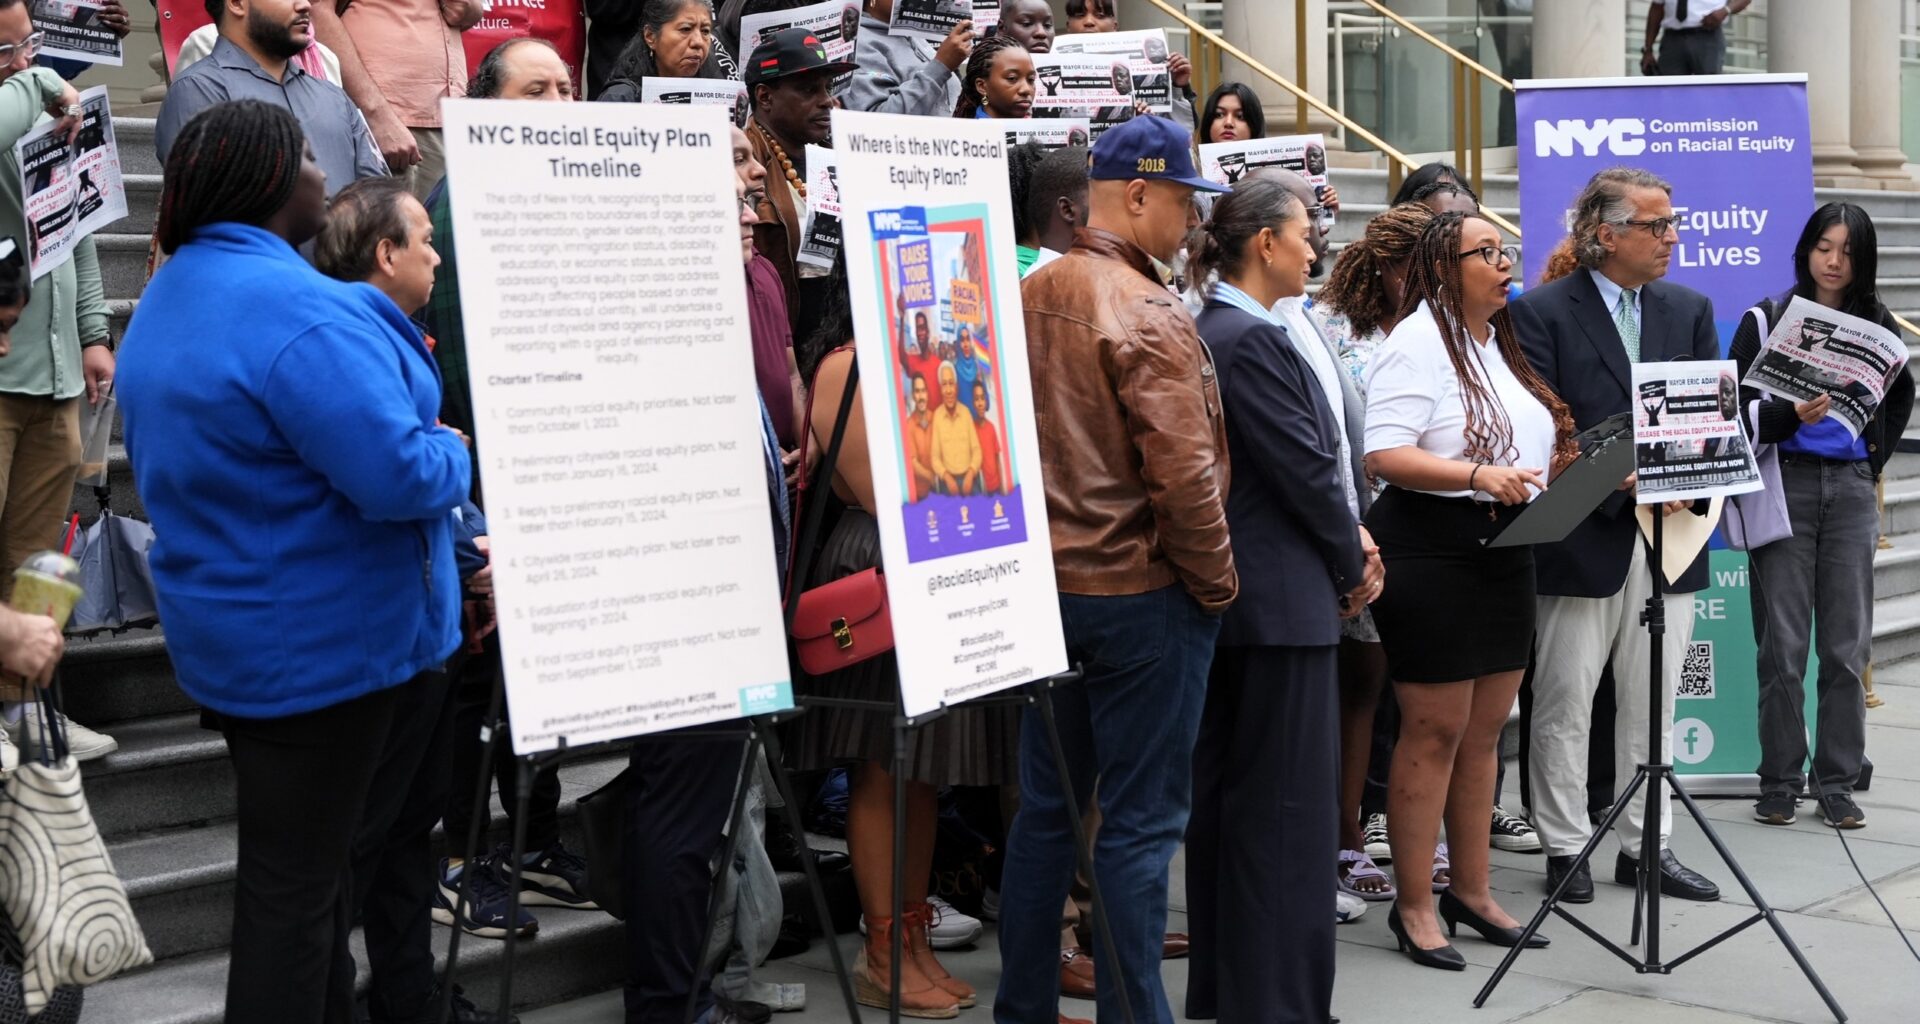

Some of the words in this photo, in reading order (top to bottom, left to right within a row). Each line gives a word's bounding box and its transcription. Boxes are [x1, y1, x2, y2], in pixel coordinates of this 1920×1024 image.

[472, 17, 512, 29] uture.
[794, 19, 814, 27] MAYOR
[902, 11, 931, 21] RELEASE
[43, 22, 60, 31] RACIAL
[61, 25, 82, 35] EQUITY
[84, 29, 99, 37] PLAN
[100, 32, 115, 40] NOW
[1650, 118, 1758, 133] Commission
[467, 124, 514, 144] NYC
[520, 124, 588, 145] Racial
[593, 126, 659, 151] Equity
[665, 127, 711, 147] Plan
[847, 133, 892, 154] Where
[894, 135, 906, 155] is
[908, 137, 930, 156] the
[933, 138, 960, 157] NYC
[963, 140, 1003, 159] Racial
[1534, 117, 1646, 157] NYC
[1650, 140, 1673, 152] on
[1678, 136, 1733, 151] Racial
[1738, 135, 1795, 153] Equity
[38, 148, 63, 165] EQUITY
[1137, 157, 1166, 173] 2018
[547, 156, 641, 177] Timeline
[889, 165, 930, 190] Equity
[933, 167, 968, 186] Plan?
[46, 184, 68, 201] EQUITY
[820, 203, 841, 212] RELEA
[873, 211, 901, 232] NYC
[1672, 204, 1768, 236] Equity
[39, 239, 60, 258] ADAMS
[815, 233, 841, 245] RELEAS
[900, 243, 928, 263] RAISE
[1678, 243, 1761, 268] Lives
[903, 264, 930, 283] YOUR
[903, 281, 933, 303] VOICE
[953, 284, 977, 303] RACIAL
[954, 302, 979, 317] EQUITY
[1839, 327, 1861, 339] MAYOR
[1862, 333, 1878, 345] ERIC
[1879, 342, 1899, 361] ADAMS
[1829, 342, 1846, 351] RACIAL
[1866, 354, 1887, 371] MATTERS
[1778, 343, 1807, 360] RELEASE
[1808, 355, 1821, 365] THE
[1822, 360, 1841, 371] RACIAL
[1865, 377, 1881, 393] PLAN
[487, 374, 532, 386] Charter
[534, 370, 583, 383] Timeline
[1762, 364, 1792, 382] RELEASE
[1792, 377, 1806, 387] THE
[1806, 382, 1829, 396] RACIAL
[1850, 398, 1865, 416] PLAN
[1637, 430, 1660, 439] RELEASE
[1691, 427, 1711, 435] EQUITY
[1711, 426, 1723, 434] PLAN
[1638, 467, 1664, 476] RELEASE
[1675, 464, 1693, 473] RACIAL
[1694, 462, 1713, 470] EQUITY
[1713, 460, 1728, 469] PLAN
[1728, 459, 1745, 467] NOW
[927, 559, 1021, 596] @RacialEquityNYC
[947, 598, 1009, 621] www.nyc.gov/CORE
[960, 629, 1004, 648] #RacialEquity
[953, 641, 1016, 665] #CommunityPower
[975, 660, 998, 674] #CORE
